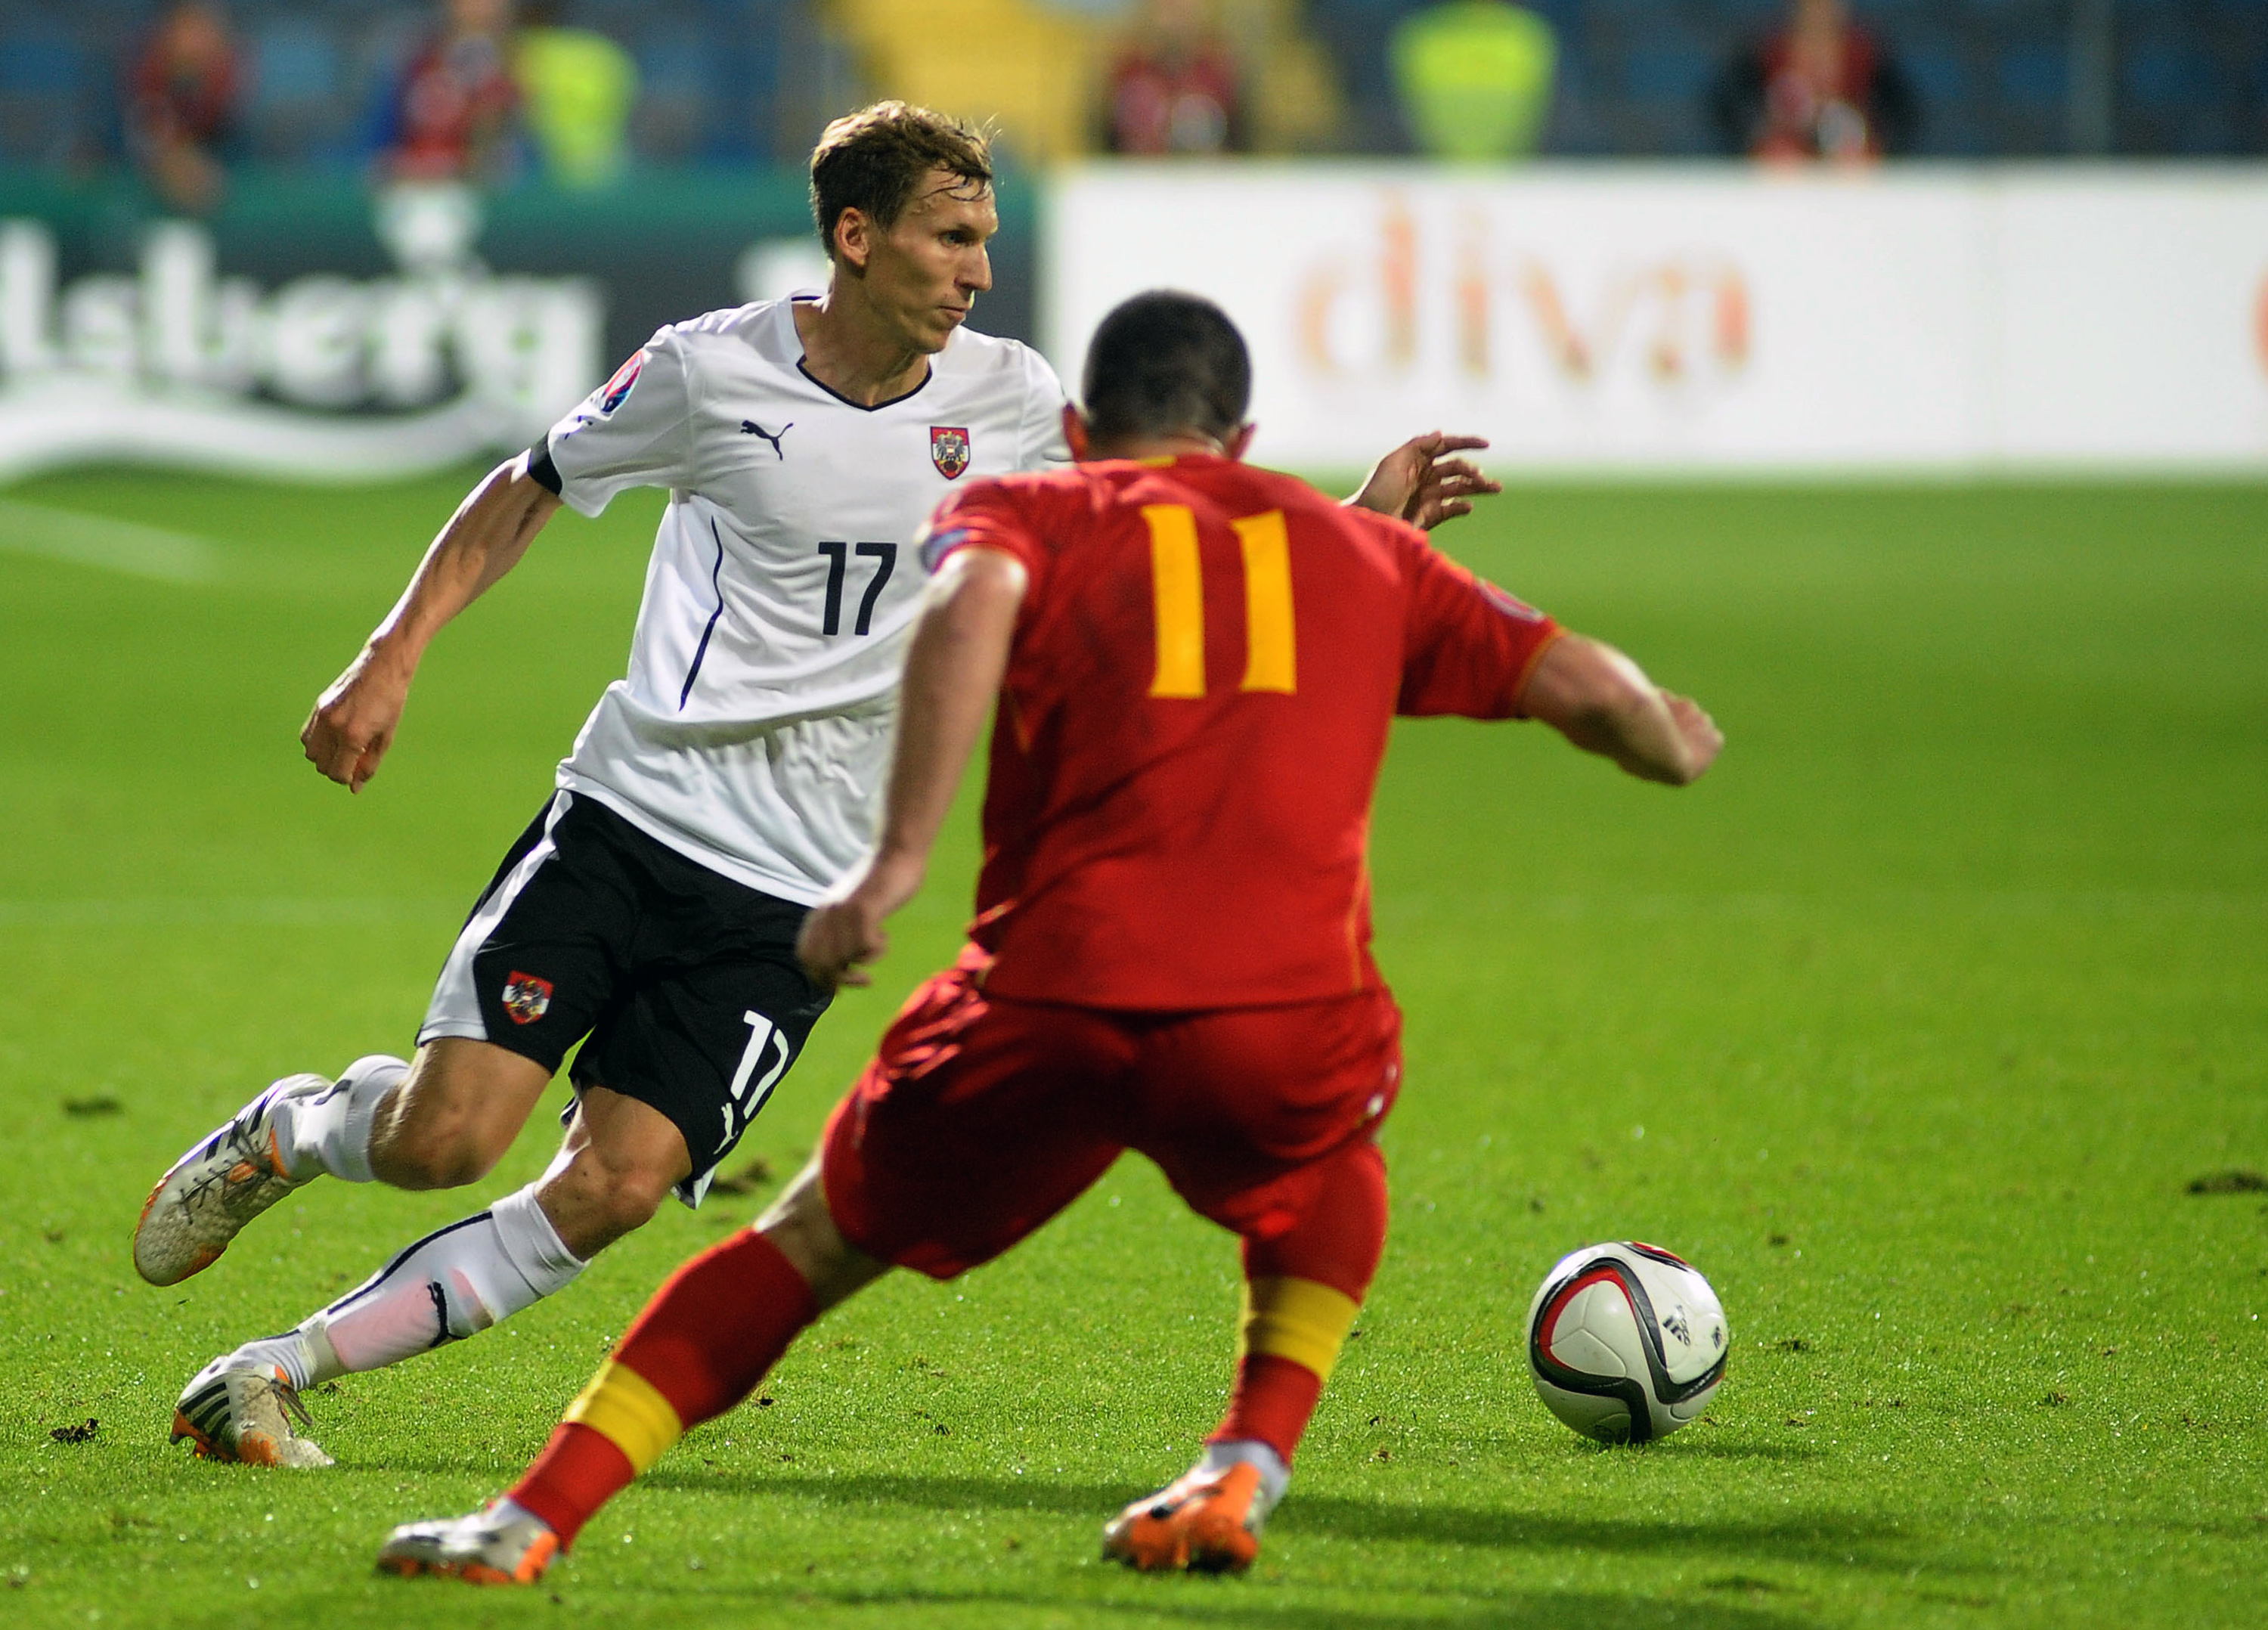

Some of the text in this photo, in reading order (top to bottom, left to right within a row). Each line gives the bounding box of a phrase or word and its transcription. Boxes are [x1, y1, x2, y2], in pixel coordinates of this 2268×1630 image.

[1291, 187, 1755, 384] diva
[817, 541, 897, 636] 17
[1141, 504, 1297, 699] 11
[730, 1009, 789, 1120] 17
